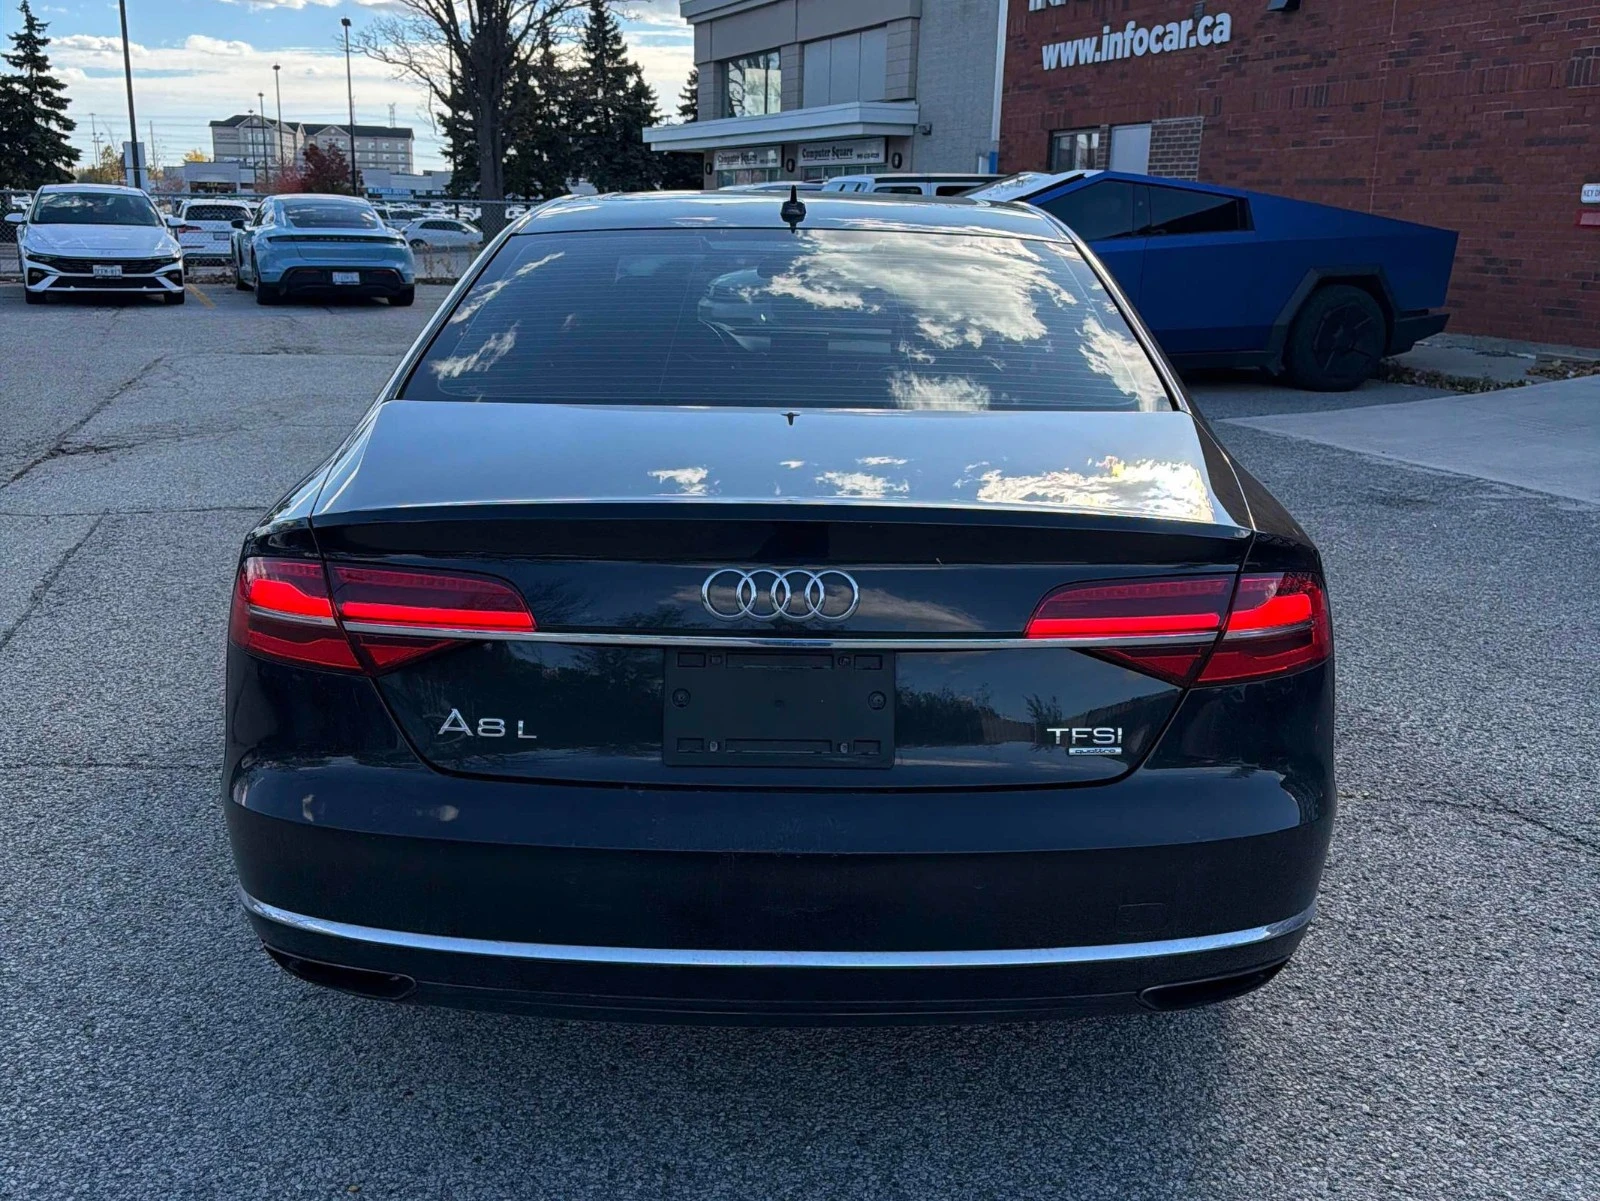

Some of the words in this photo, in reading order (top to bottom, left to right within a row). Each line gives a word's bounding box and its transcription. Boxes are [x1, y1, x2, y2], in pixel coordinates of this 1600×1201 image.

[1041, 12, 1232, 71] www.infocar.ca
[802, 147, 831, 160] Computer
[831, 146, 854, 159] Square
[1046, 727, 1123, 745] TFSI
